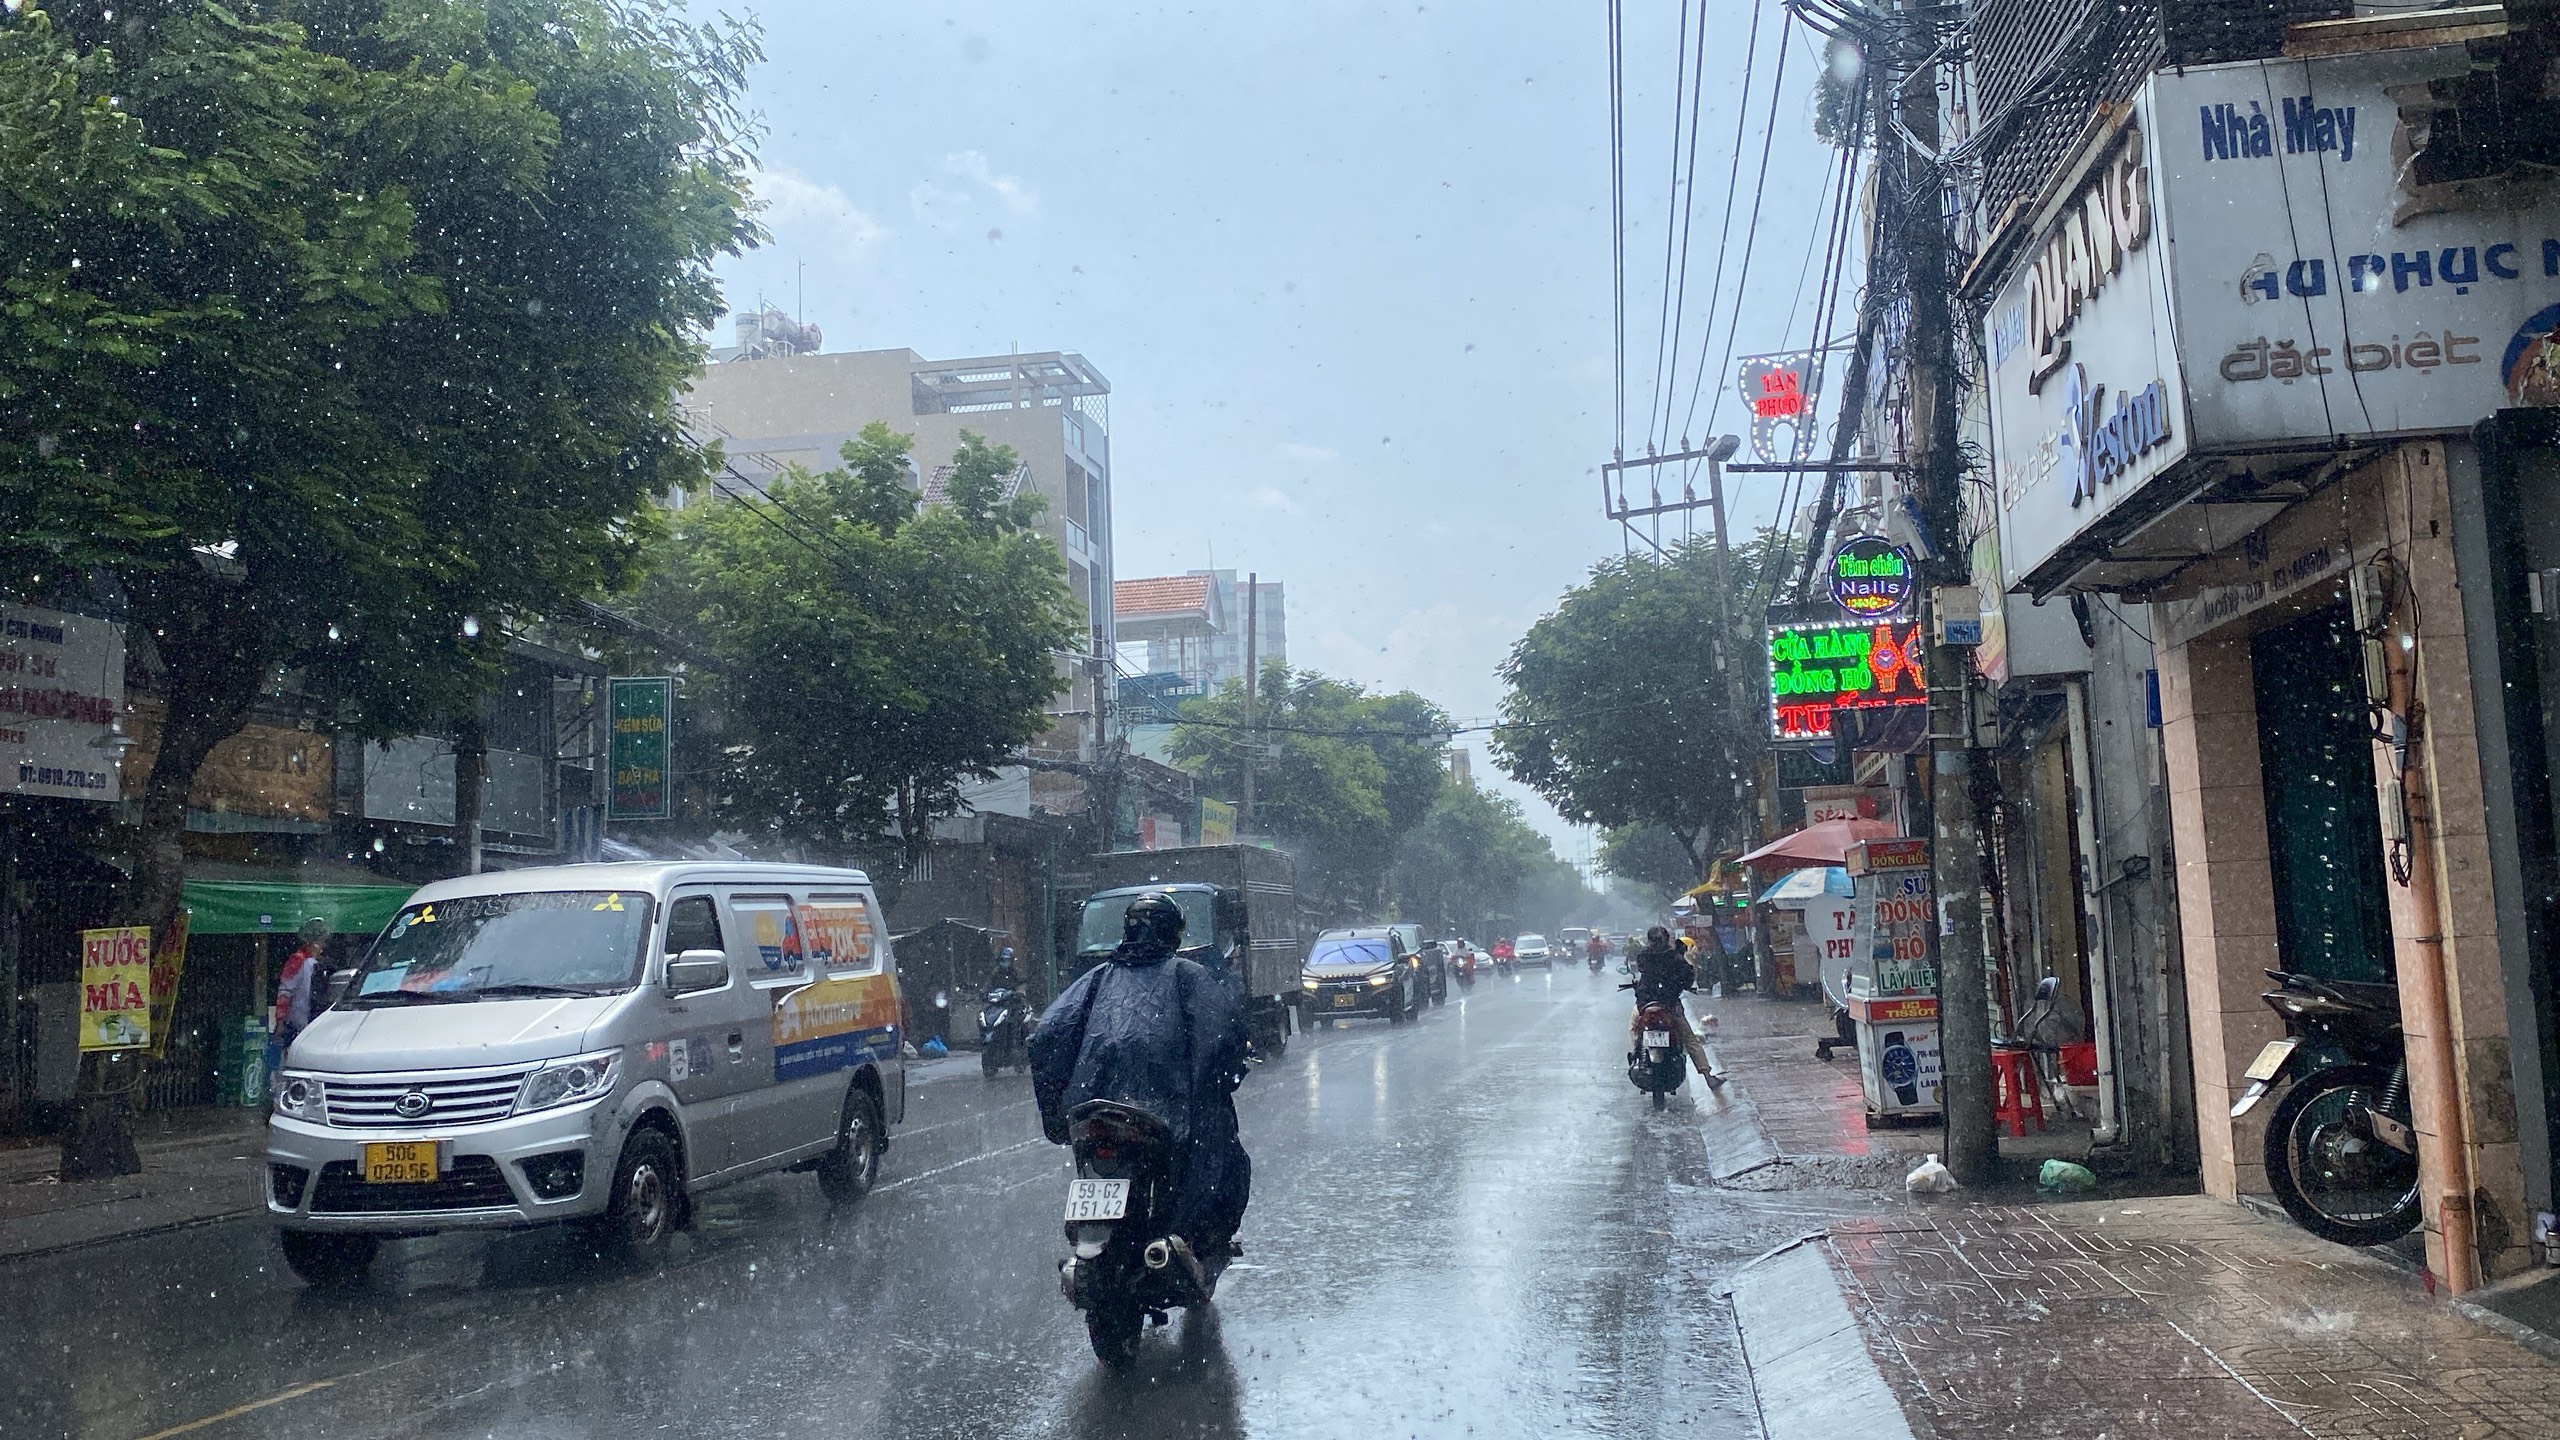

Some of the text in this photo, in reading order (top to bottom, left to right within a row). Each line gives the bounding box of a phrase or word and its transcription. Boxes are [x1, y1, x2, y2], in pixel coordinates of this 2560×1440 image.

[2200, 96, 2356, 161] Nhà May
[2024, 130, 2151, 395] QUANG
[2348, 243, 2519, 295] PHỤC
[2219, 330, 2481, 385] đặc biệt
[2064, 376, 2172, 501] Veston
[1841, 581, 1899, 594] Nails
[1774, 629, 1871, 661] CỬA HÀNG
[1775, 655, 1872, 695] ĐỒNG HỒ
[86, 930, 147, 968] NƯỚC
[1893, 924, 1926, 960] HỒ
[85, 974, 146, 1012] MÍA
[1886, 1008, 1937, 1018] TISSOT
[1920, 1066, 1936, 1074] LAU
[1071, 1200, 1123, 1218] 151.42
